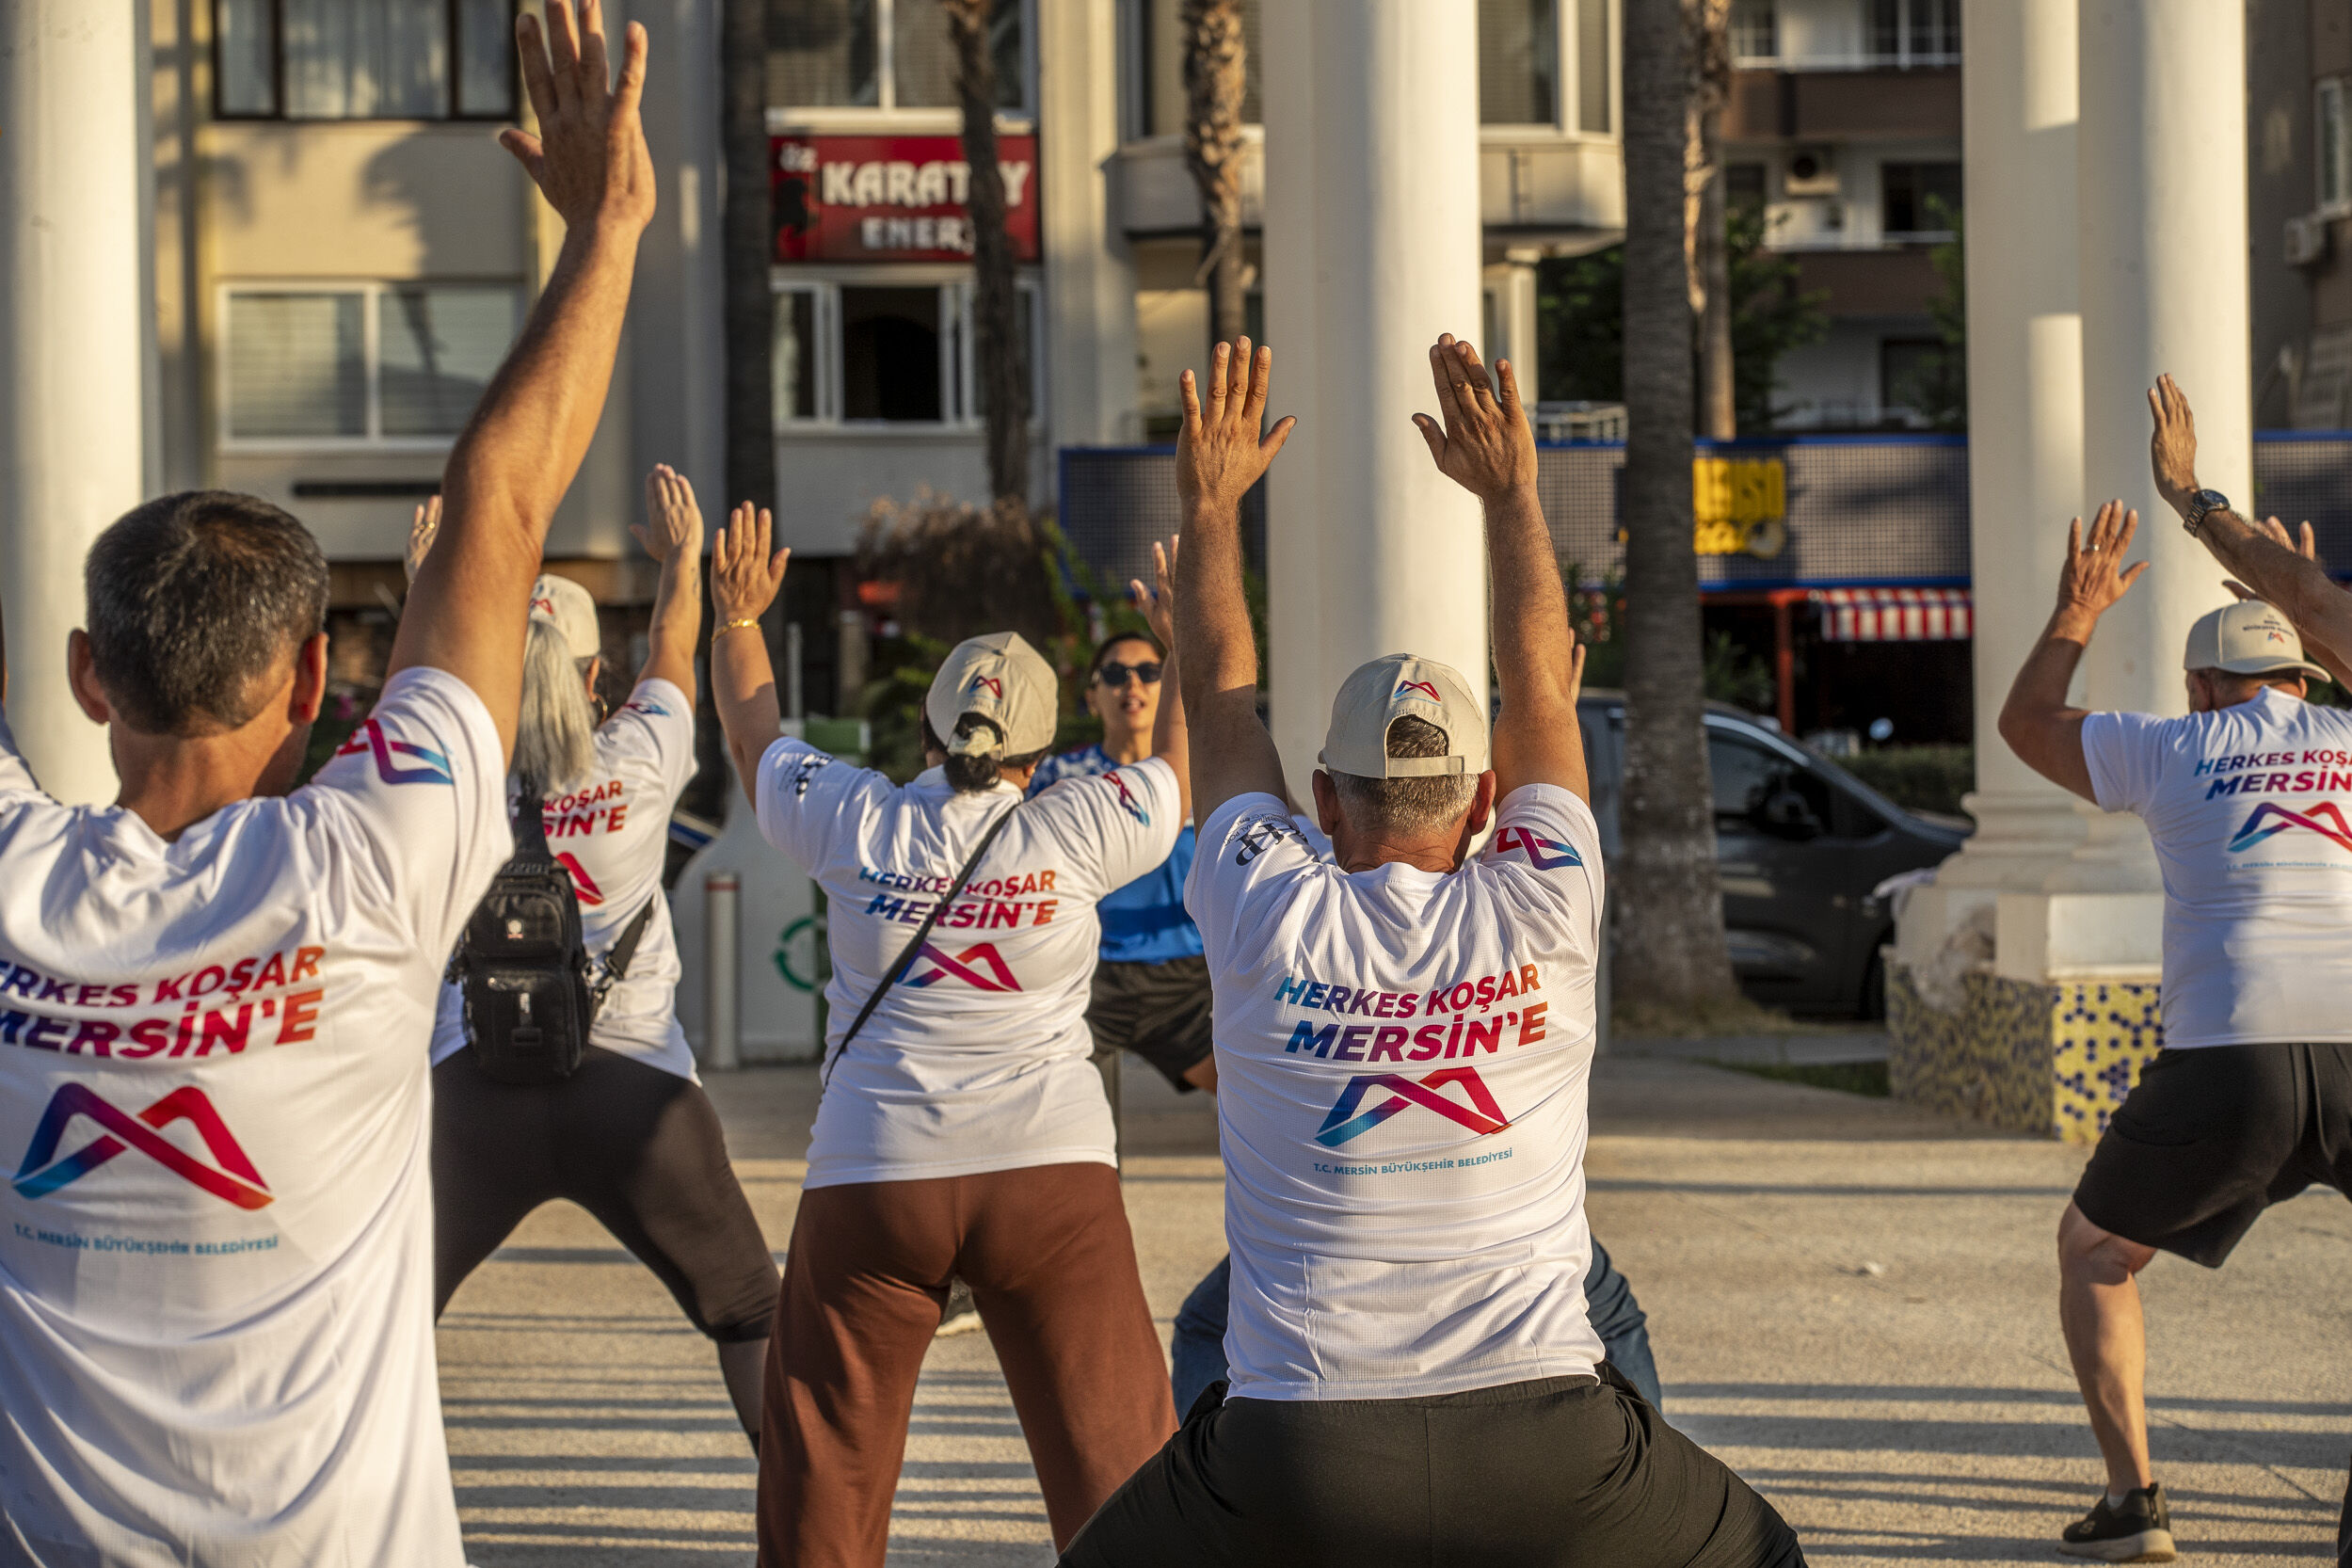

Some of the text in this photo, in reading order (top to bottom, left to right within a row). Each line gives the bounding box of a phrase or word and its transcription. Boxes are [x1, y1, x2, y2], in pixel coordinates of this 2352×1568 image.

[821, 160, 1032, 208] KARATY
[2194, 749, 2352, 777] HERKES KOŞ
[859, 867, 1056, 899] HERKE KOŞAR
[153, 946, 327, 1004] KOŞAR
[1274, 963, 1542, 1019] HERKES KOŞAR
[1285, 1000, 1549, 1063] MERSİN'E
[1313, 1146, 1513, 1176] T.C. MERSİN BÜYÜKŞEHİR BELEDİYESİ
[195, 1233, 279, 1256] BELEDİYESİ
